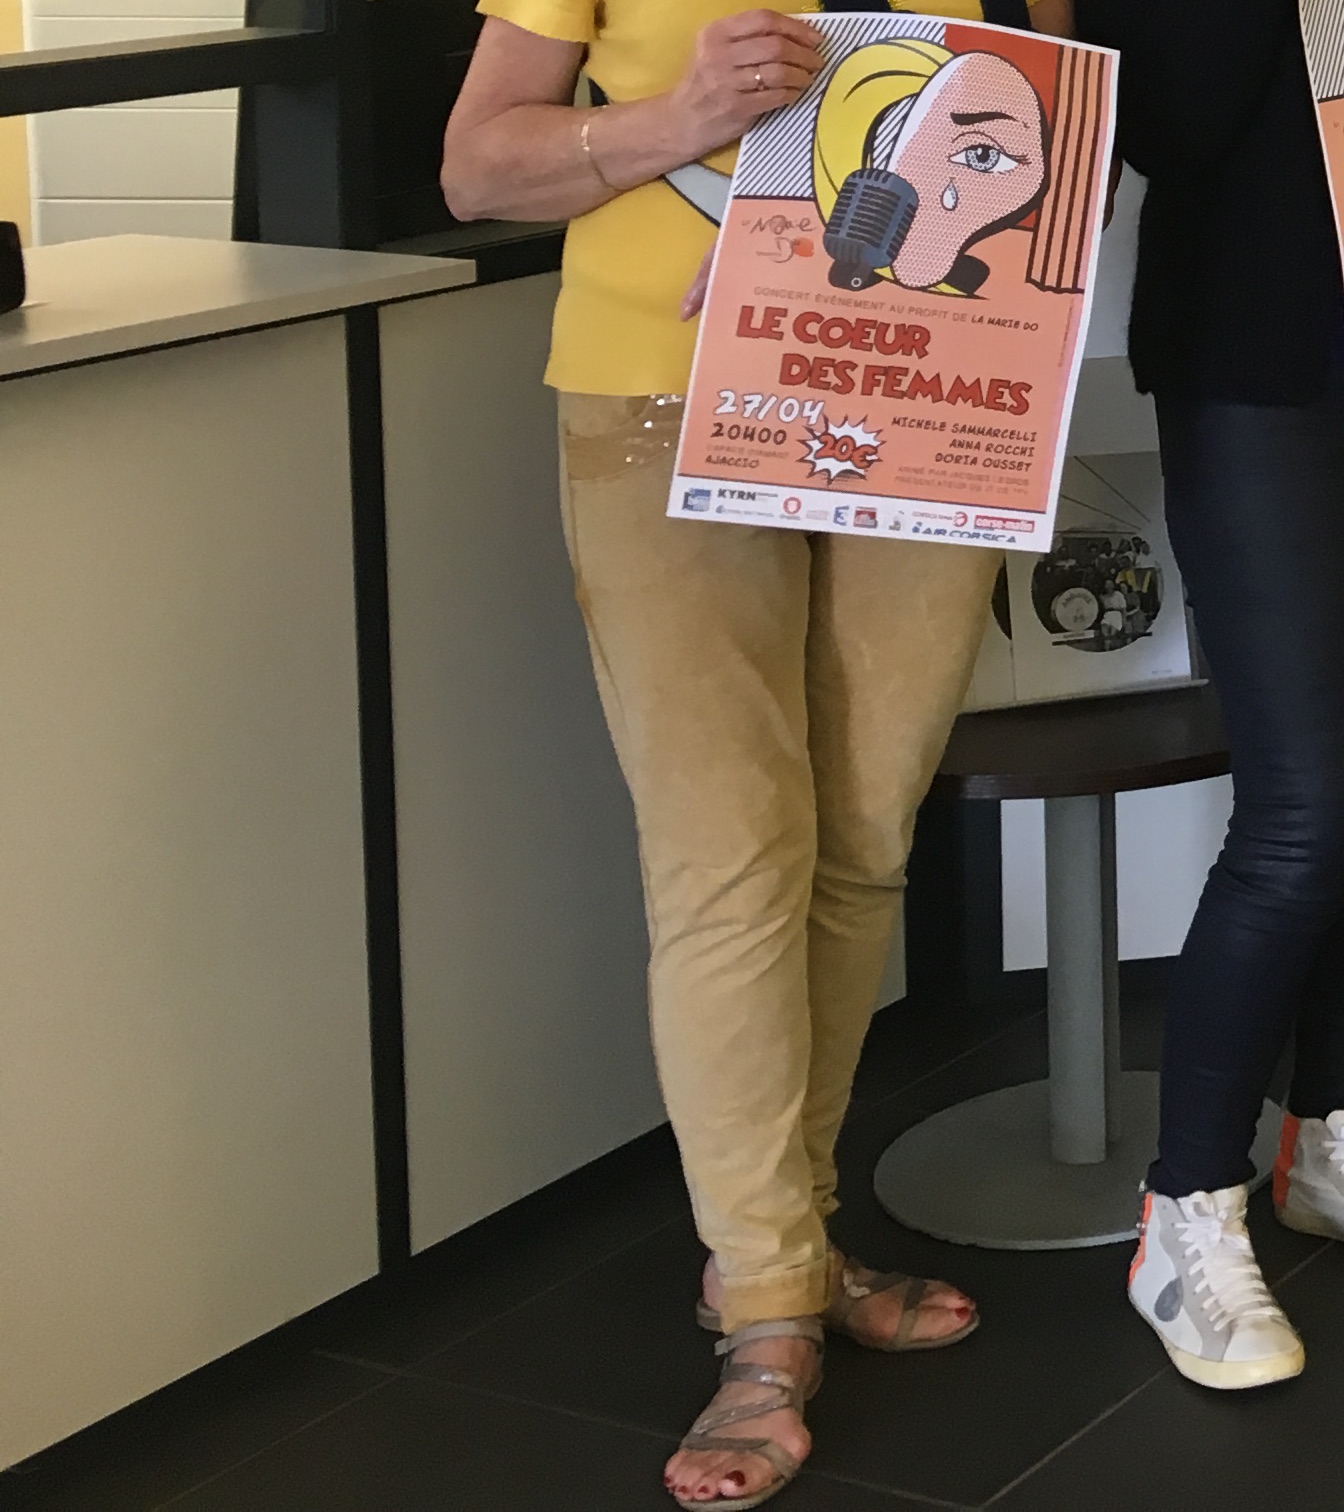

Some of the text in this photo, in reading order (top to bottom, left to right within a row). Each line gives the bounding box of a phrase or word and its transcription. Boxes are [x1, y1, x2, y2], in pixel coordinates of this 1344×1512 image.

[736, 305, 931, 359] LE COEUR
[779, 353, 1033, 415] DES FEMMES
[713, 389, 825, 426] 27/04
[710, 422, 787, 447] 20H00
[891, 416, 1038, 442] MICHELE SAMMARCELLI
[815, 434, 878, 469] 20€
[935, 453, 978, 465] DORIA
[948, 439, 1035, 457] ANNA ROCCHI
[704, 455, 760, 470] AJACCIO
[717, 488, 756, 501] KYRN
